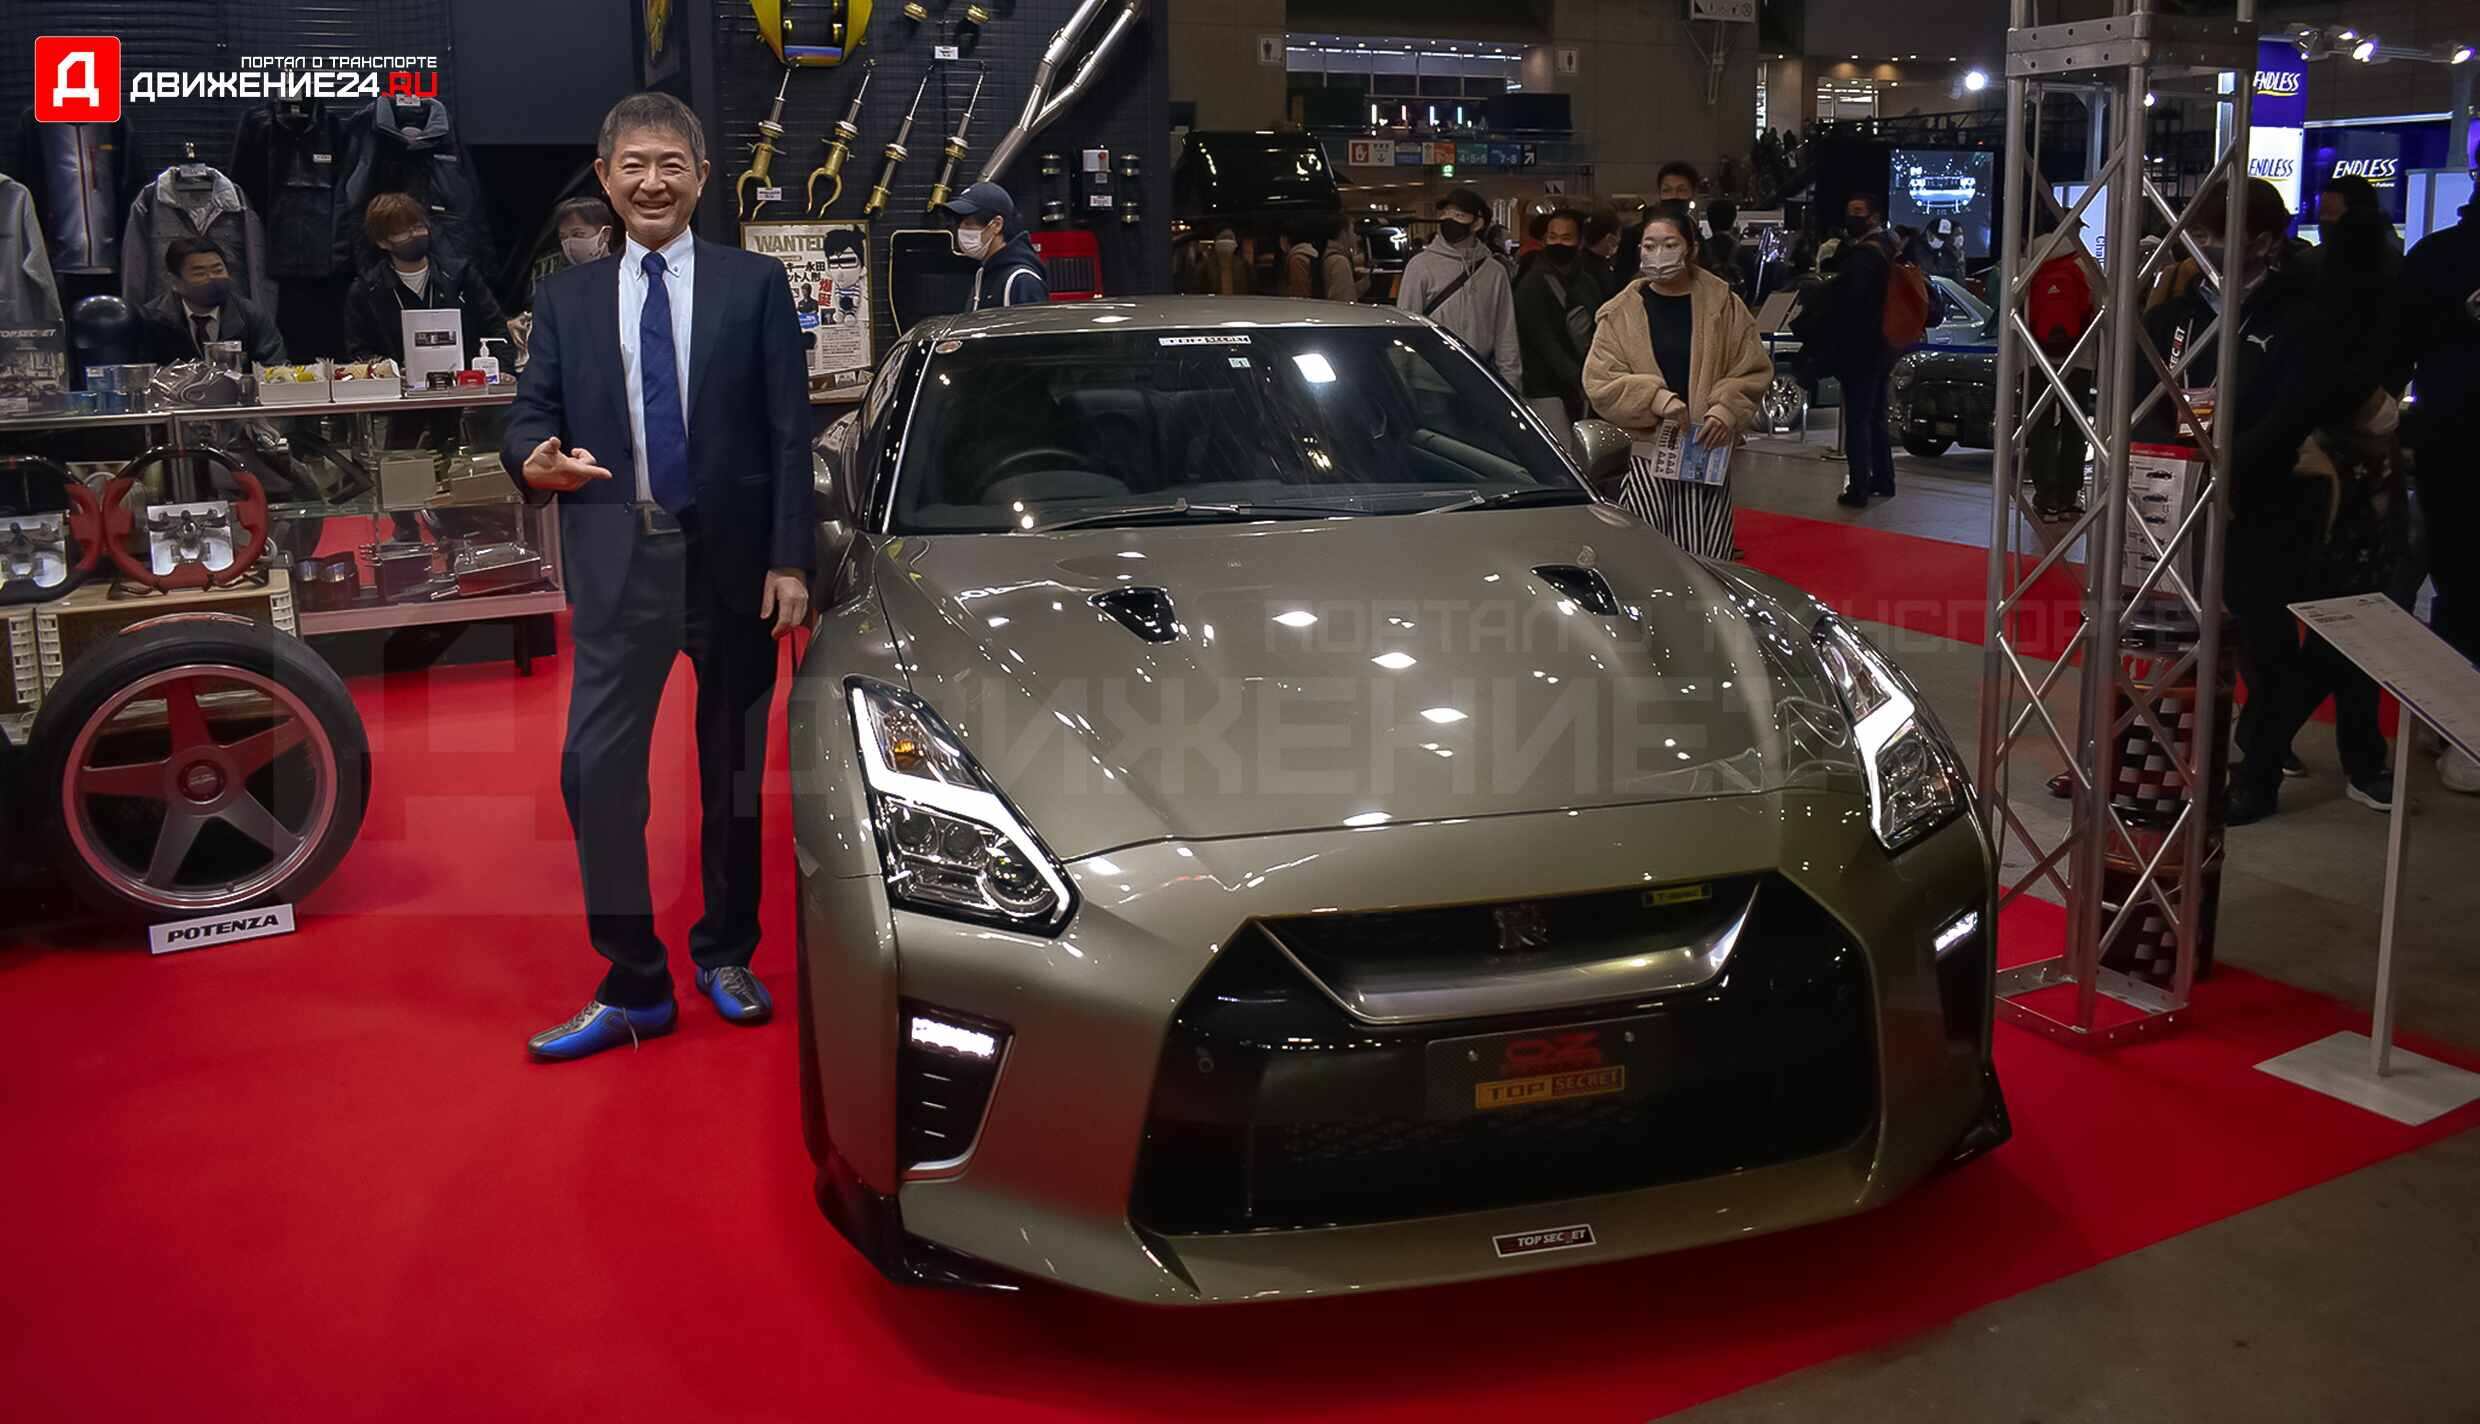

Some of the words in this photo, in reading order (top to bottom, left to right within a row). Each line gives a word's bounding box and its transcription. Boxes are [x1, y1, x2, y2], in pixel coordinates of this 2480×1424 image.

[2253, 70, 2300, 92] ENDLESS
[2250, 158, 2294, 178] ENDLESS
[2332, 158, 2399, 179] ENDLESS
[167, 914, 280, 943] POTENZA
[1489, 1082, 1546, 1101] TOP
[1554, 1068, 1622, 1091] SECRET
[1517, 1235, 1542, 1247] TOP
